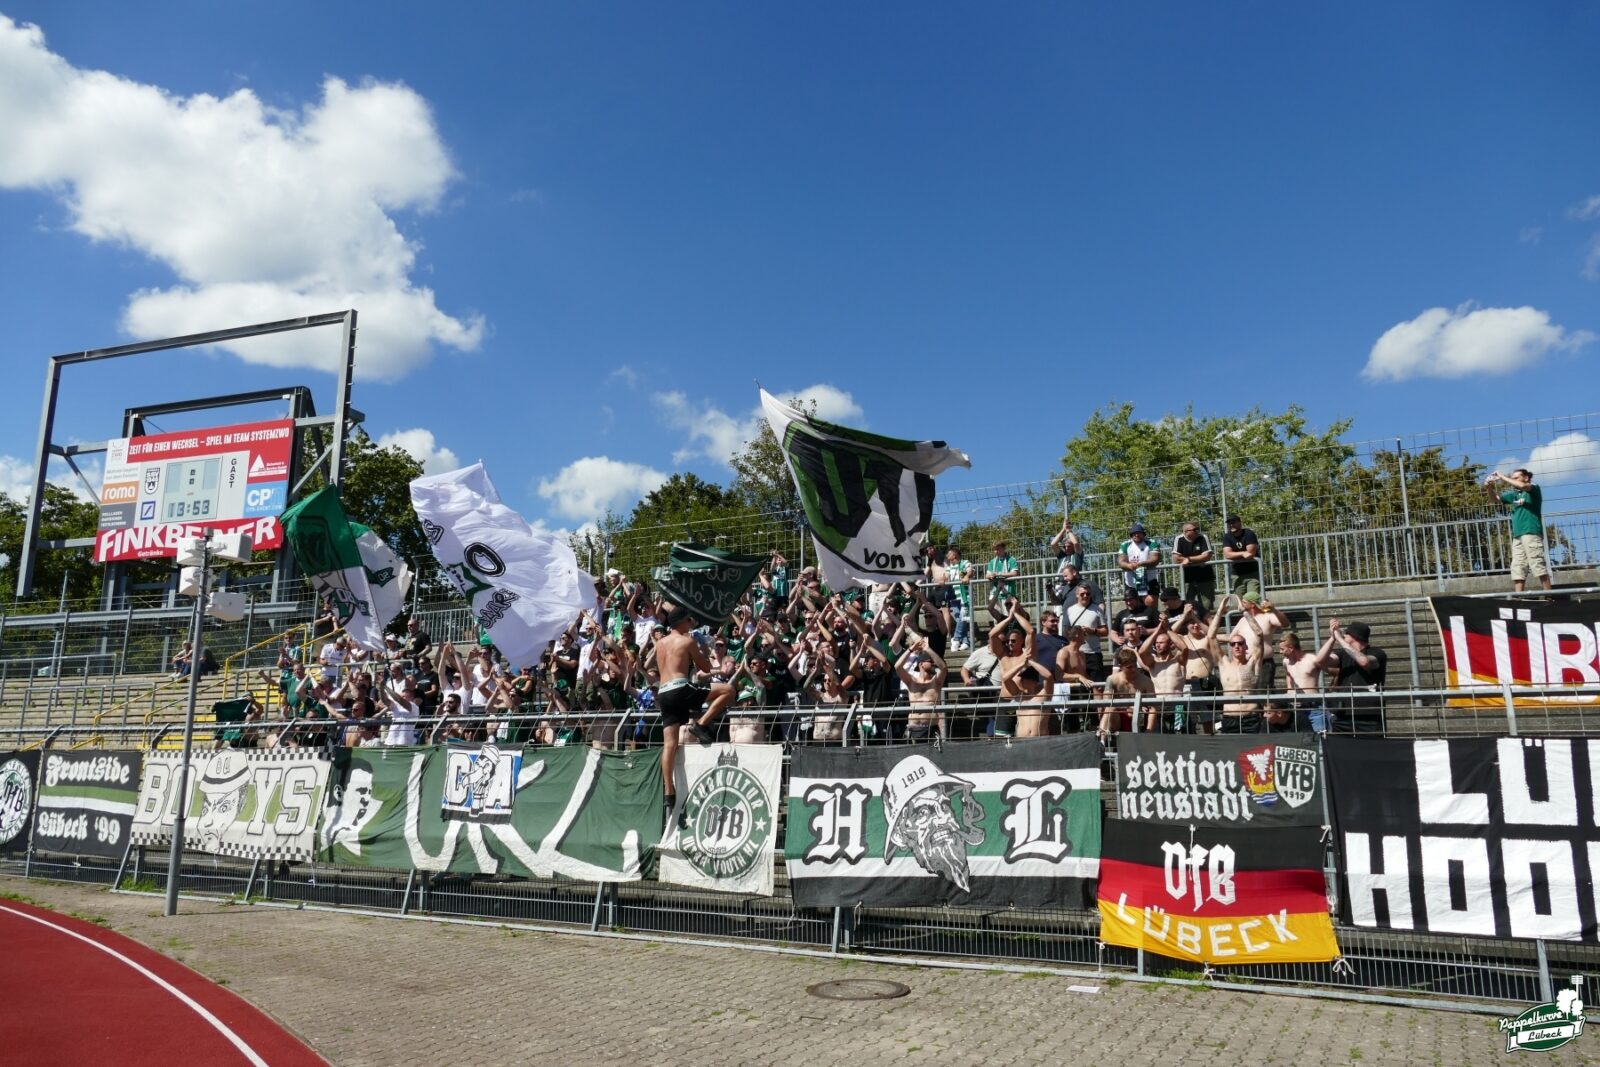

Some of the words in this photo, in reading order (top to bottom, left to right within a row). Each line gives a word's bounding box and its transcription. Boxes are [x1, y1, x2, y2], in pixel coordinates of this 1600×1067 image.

[128, 445, 142, 455] ZEIT
[142, 442, 153, 453] FÜR
[154, 441, 171, 452] EINEN
[172, 438, 199, 450] WECHSEL
[206, 436, 223, 447] SPIEL
[224, 434, 232, 444] IM
[233, 432, 250, 443] TEAM
[229, 458, 237, 488] GAST
[104, 486, 136, 500] roma
[1450, 608, 1600, 702] LÜB
[1125, 750, 1238, 790] sektion
[1276, 746, 1316, 763] LÜBECK
[692, 770, 764, 809] SUBKULTUR
[901, 766, 927, 788] 1919
[1276, 761, 1315, 792] VfB
[1414, 738, 1600, 827] LÜ
[1121, 785, 1254, 821] neustadt
[1283, 790, 1305, 801] 1919
[704, 805, 744, 841] VfB
[1161, 841, 1237, 912] VfB
[1345, 832, 1600, 942] HOO
[1117, 892, 1299, 957] LÜBECK
